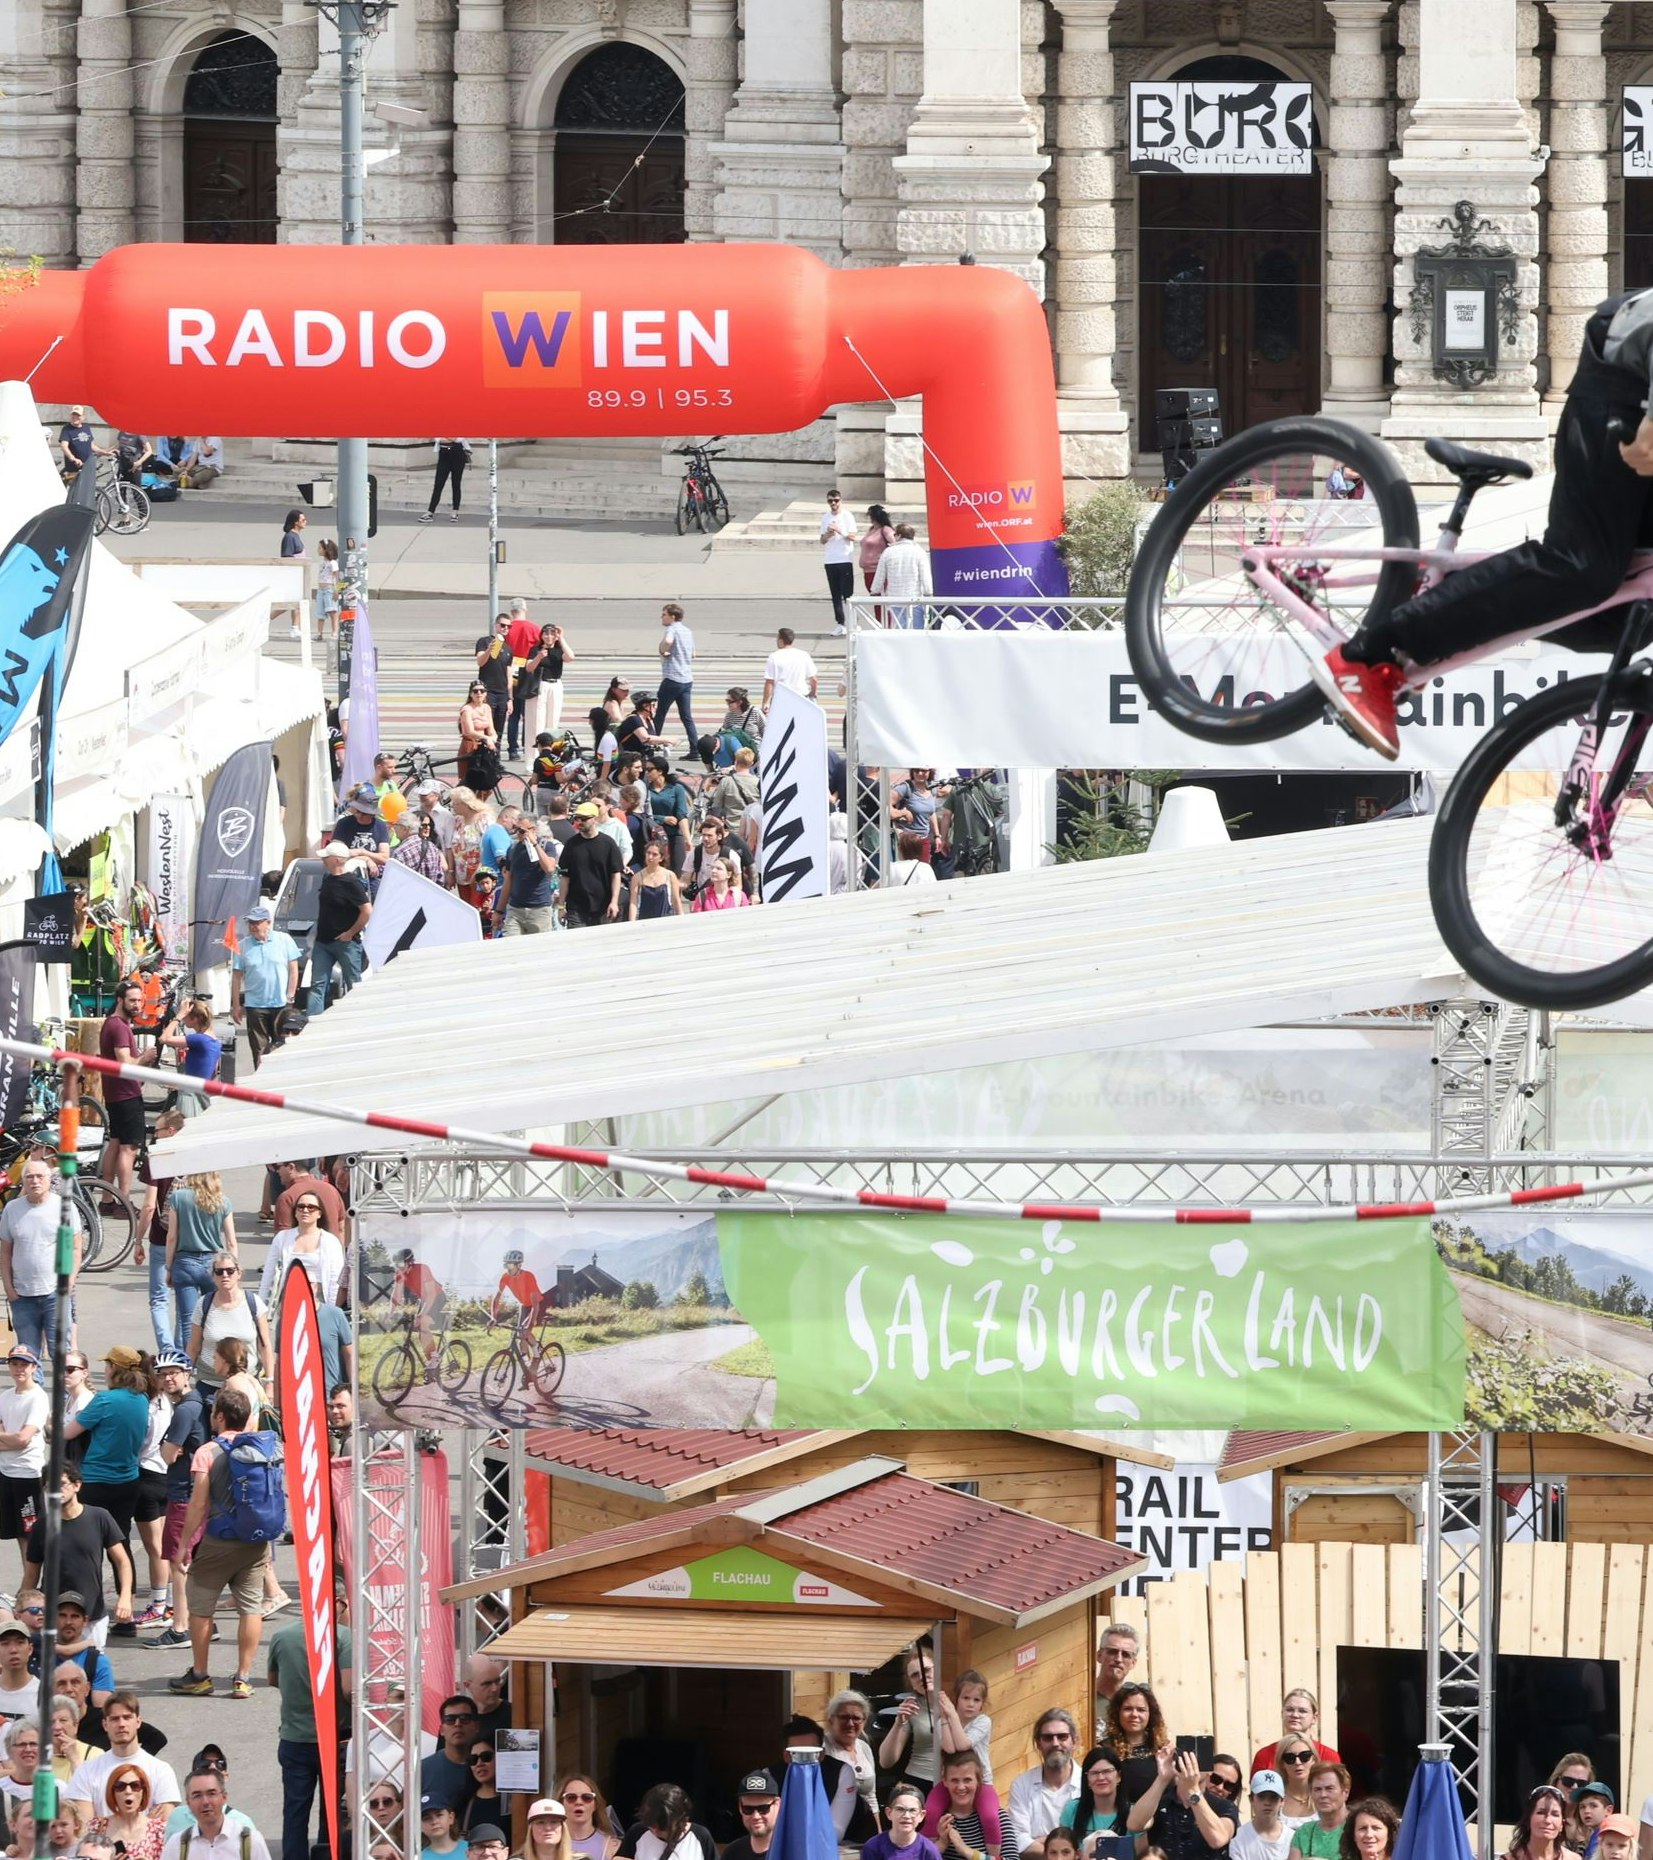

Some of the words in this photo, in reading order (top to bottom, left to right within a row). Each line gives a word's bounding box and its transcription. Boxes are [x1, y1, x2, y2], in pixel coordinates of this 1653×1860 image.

[1137, 147, 1304, 164] BURGTHEATER
[167, 308, 446, 369] RADIO
[491, 309, 729, 368] WIEN
[586, 389, 647, 408] 89.9
[675, 388, 732, 407] 95.3
[948, 491, 1003, 507] RADIO
[1011, 486, 1032, 504] W
[976, 517, 1033, 529] wien.ORF.at
[954, 565, 1033, 582] #wiendrin
[27, 932, 70, 940] RADPLATZ
[0, 976, 20, 1128] GRANILLE
[1116, 1476, 1220, 1519] RAIL
[713, 1572, 771, 1585] FLACHAU
